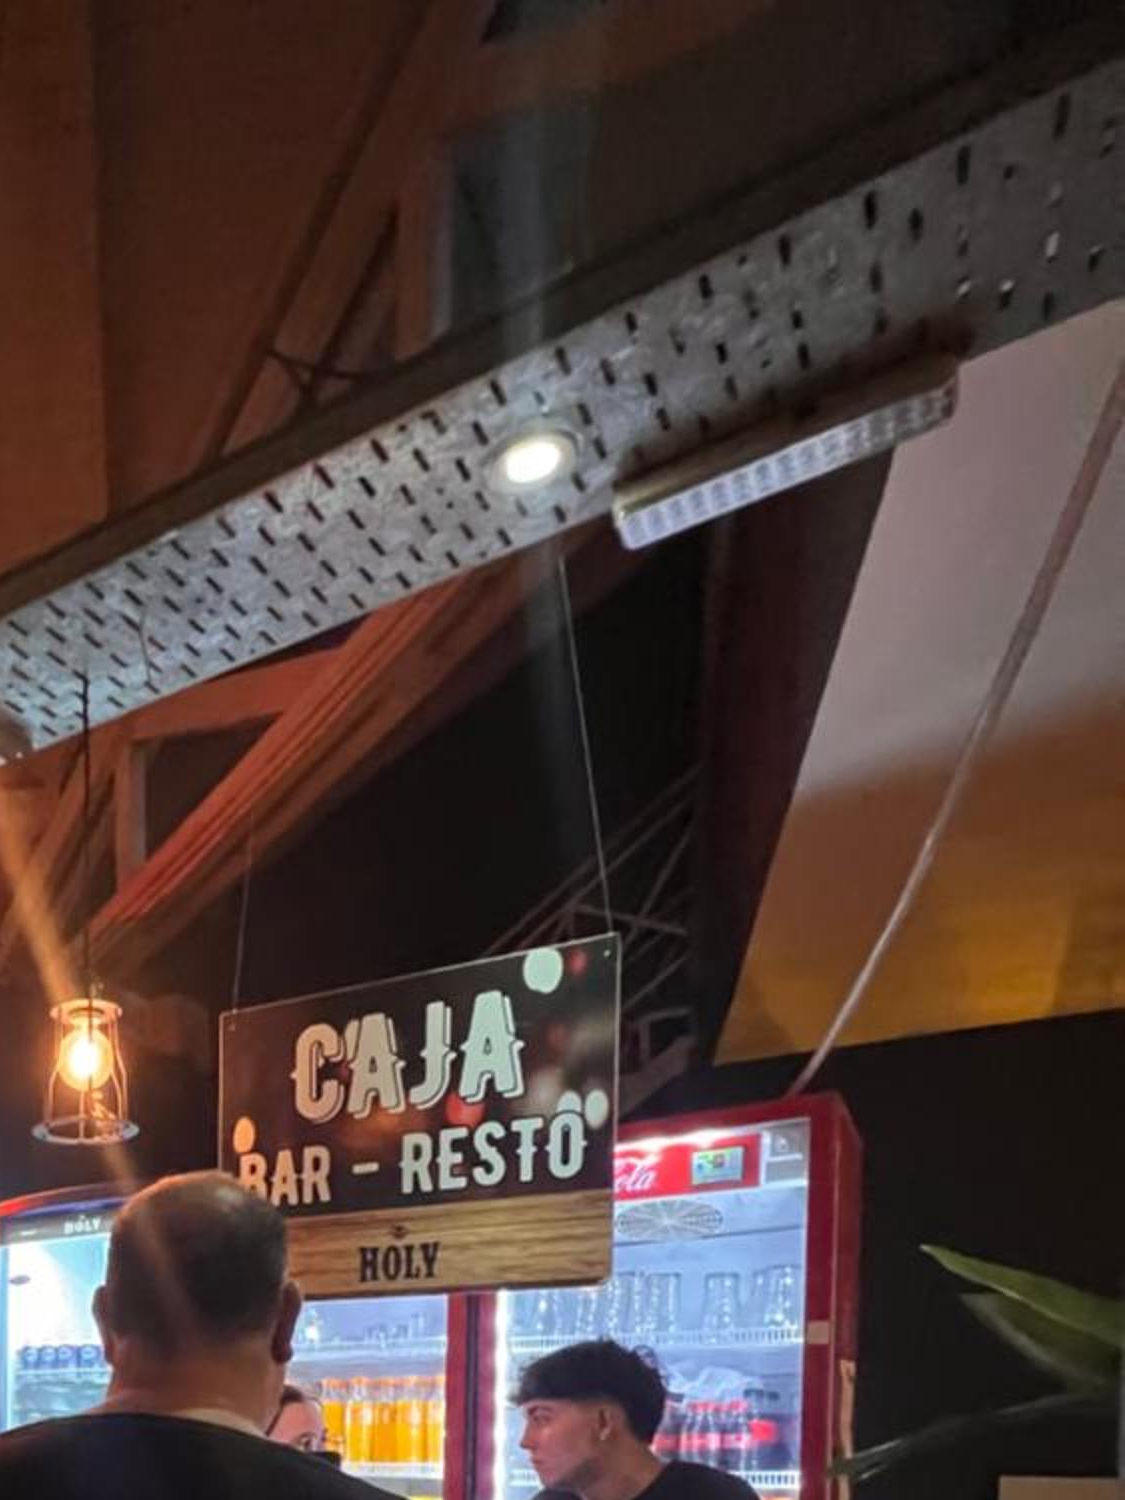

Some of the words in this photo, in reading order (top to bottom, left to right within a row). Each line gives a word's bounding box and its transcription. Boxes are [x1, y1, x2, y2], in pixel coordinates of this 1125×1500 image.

[290, 990, 524, 1124] CAJA
[239, 1146, 331, 1206] BAR
[358, 1241, 441, 1283] HOLY
